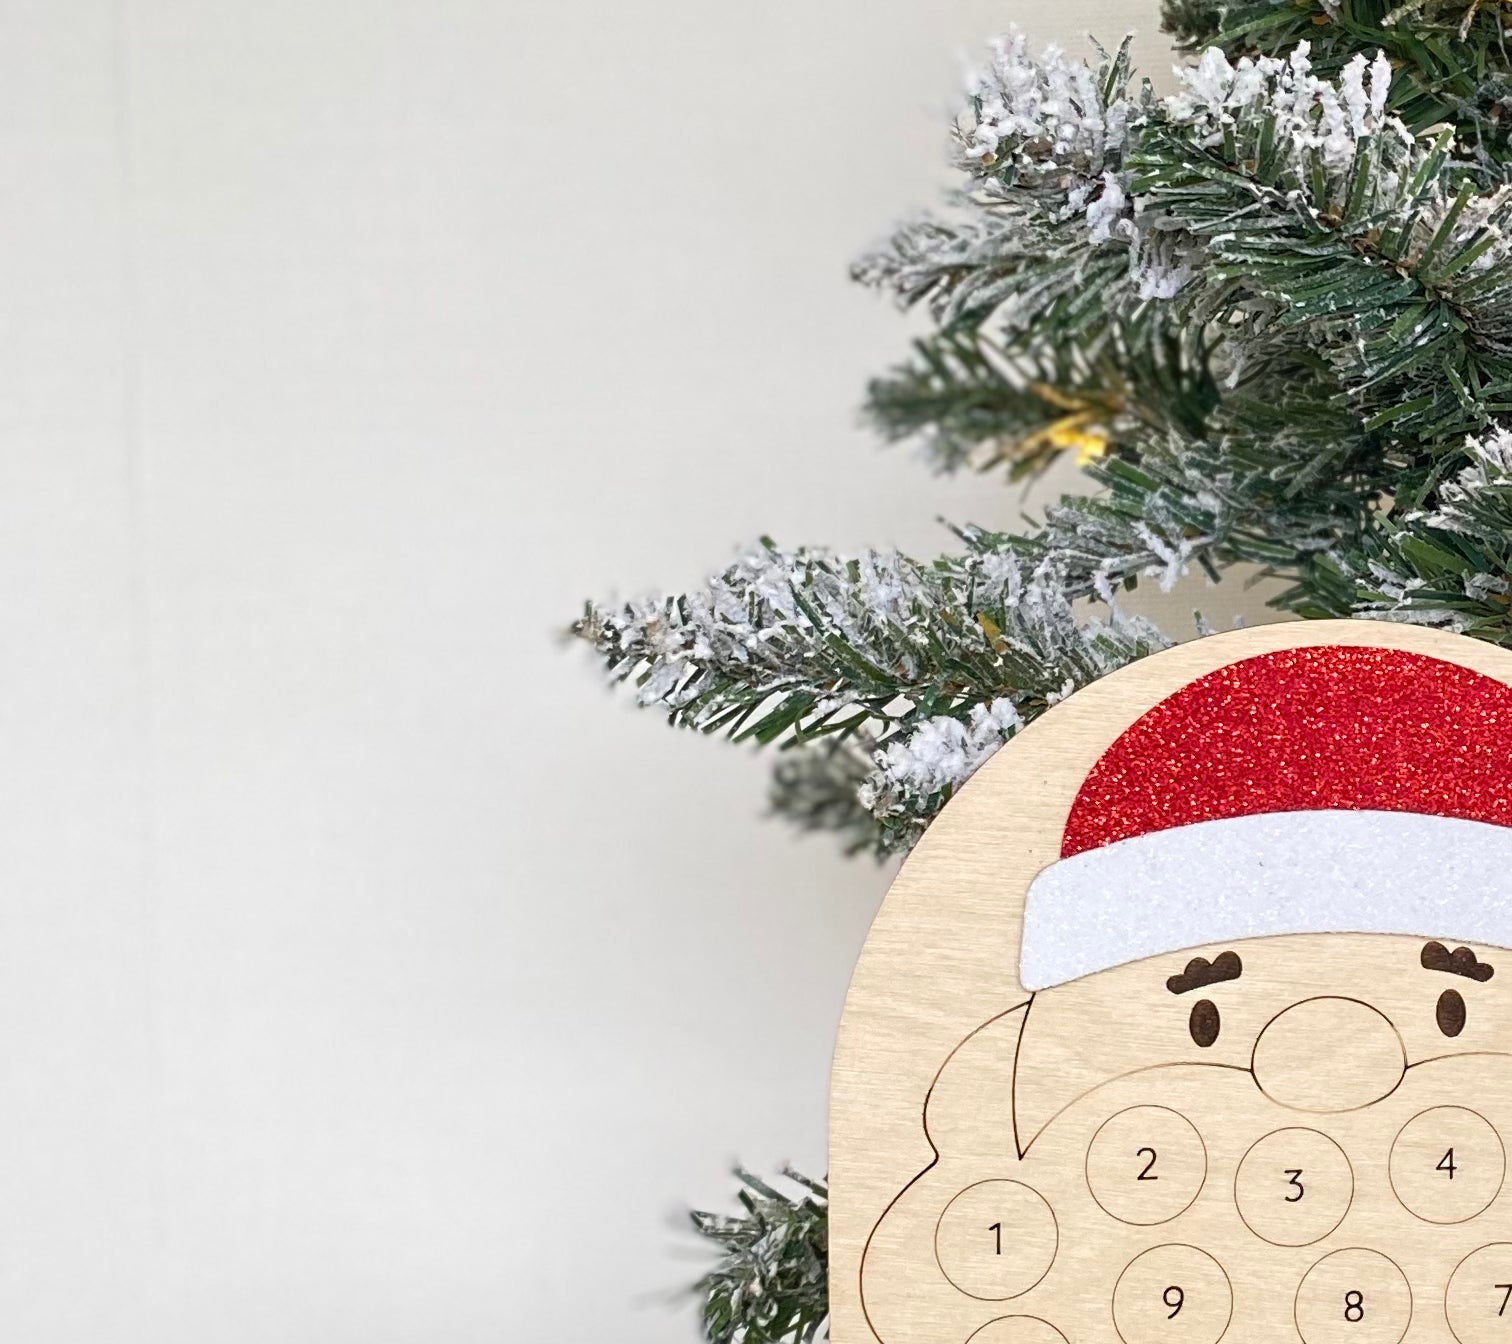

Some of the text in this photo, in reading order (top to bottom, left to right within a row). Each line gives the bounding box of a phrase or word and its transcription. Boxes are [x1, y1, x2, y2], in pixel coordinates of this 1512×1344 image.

[1135, 1146, 1160, 1182] 2
[1434, 1146, 1459, 1181] 4
[1282, 1167, 1306, 1204] 3
[987, 1221, 1003, 1257] 1
[1161, 1284, 1186, 1321] 9
[1343, 1288, 1366, 1324] 8
